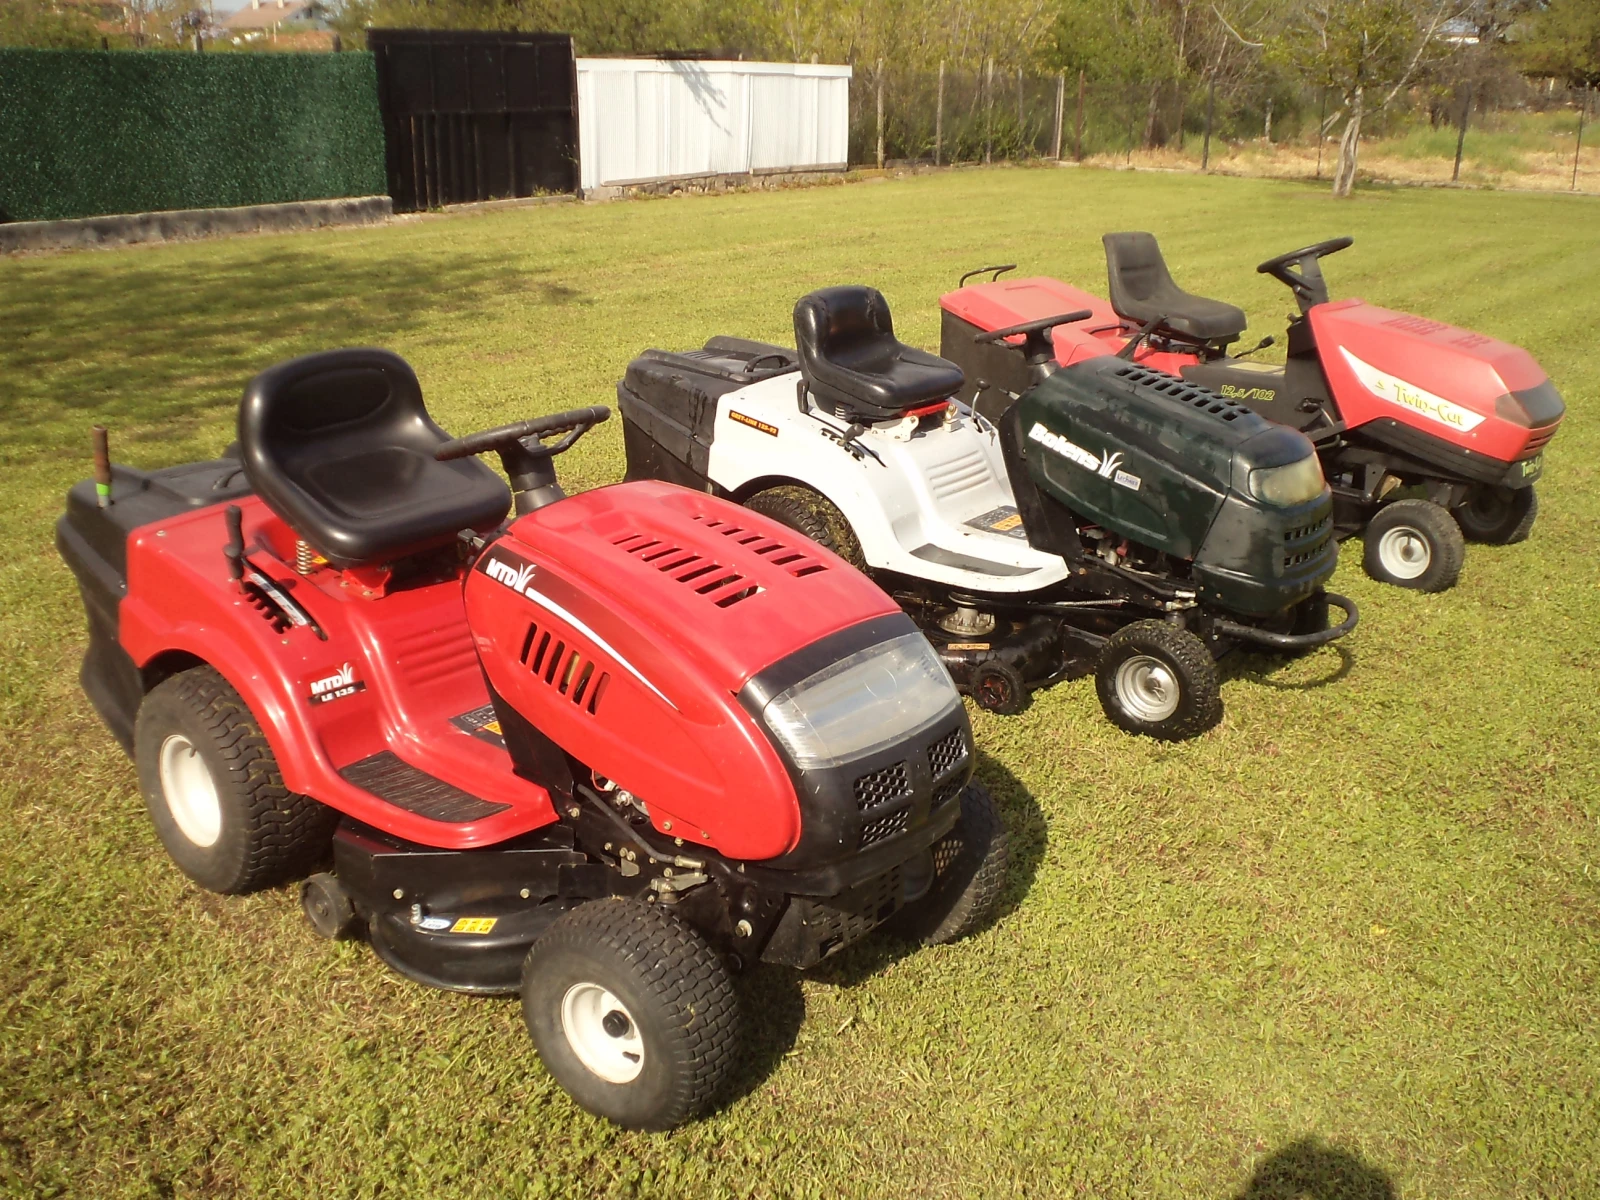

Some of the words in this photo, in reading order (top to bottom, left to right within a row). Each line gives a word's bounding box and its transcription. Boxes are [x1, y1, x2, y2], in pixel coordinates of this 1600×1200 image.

[1393, 383, 1464, 426] Twin-Cut
[1028, 422, 1102, 471] Bolens
[485, 557, 519, 587] MTD
[310, 675, 343, 695] MTD
